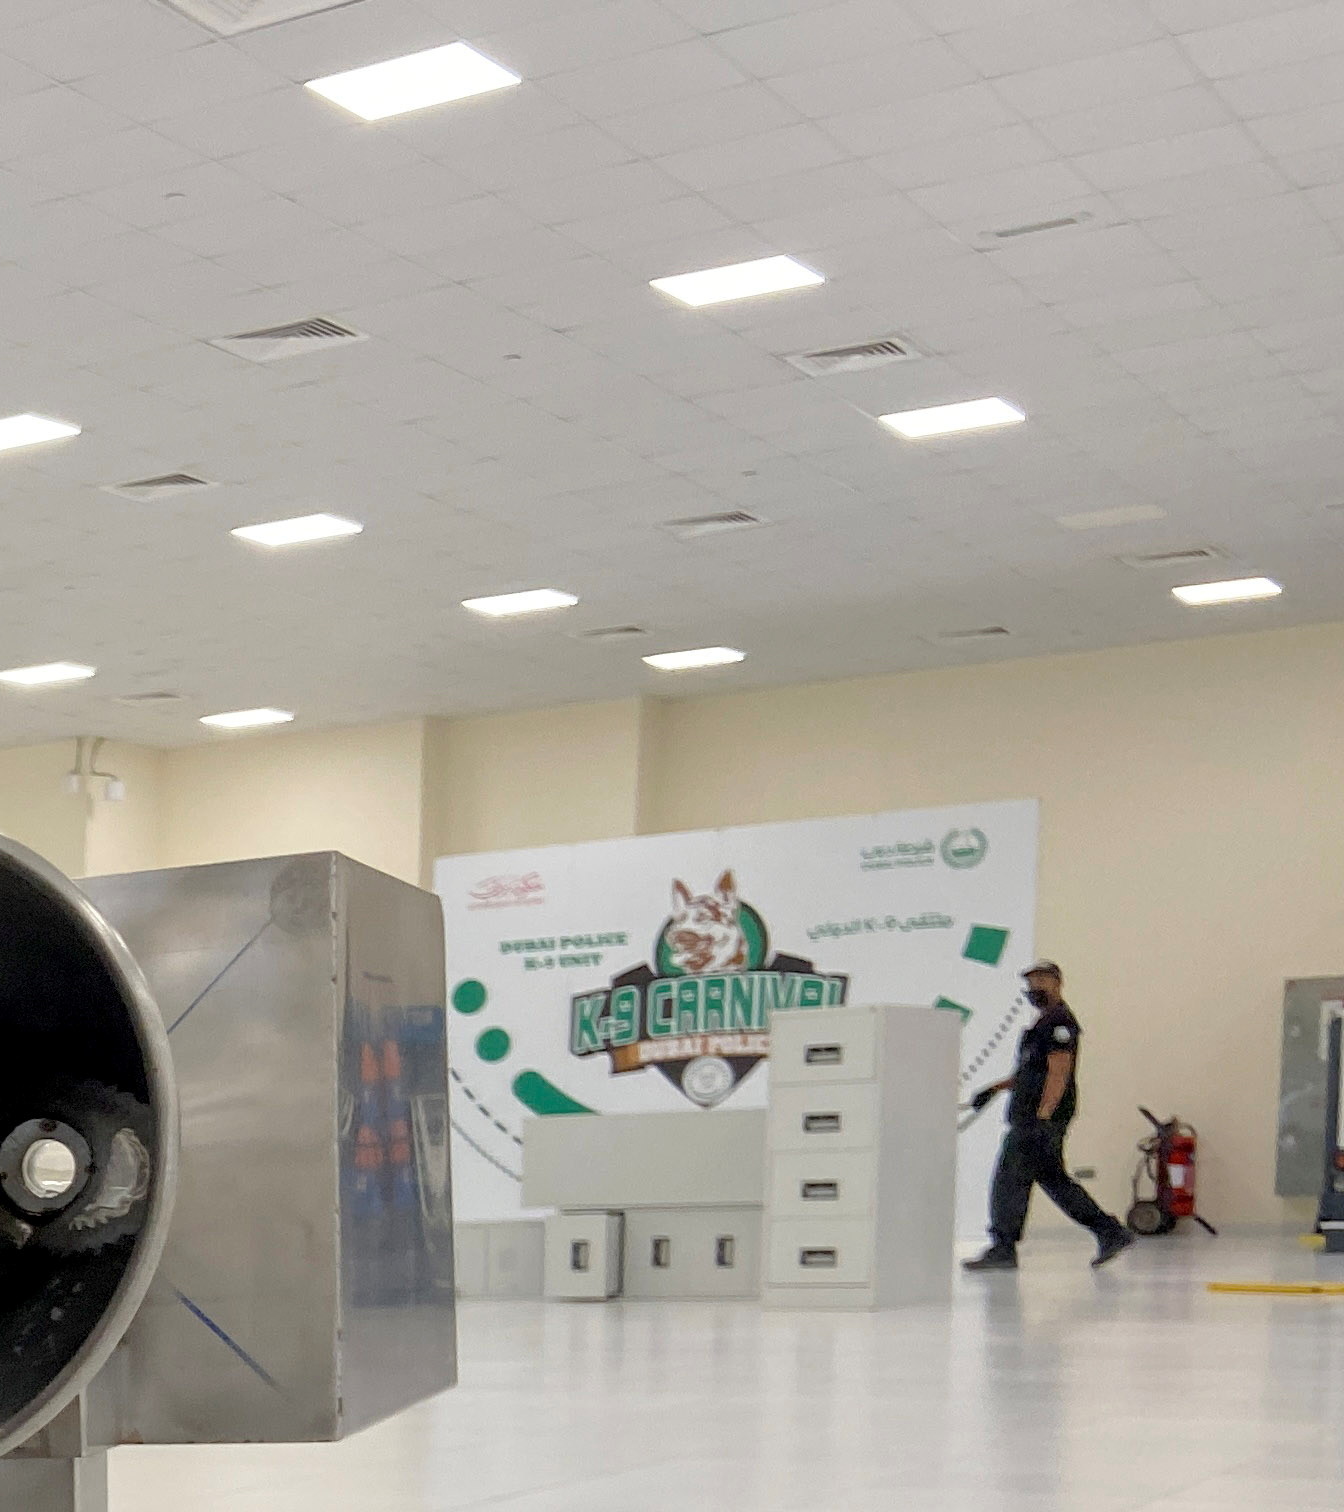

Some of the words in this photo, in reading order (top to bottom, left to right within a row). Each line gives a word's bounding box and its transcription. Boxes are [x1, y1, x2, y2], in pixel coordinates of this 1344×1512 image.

[499, 936, 555, 955] DUBAI
[559, 931, 629, 950] POLICE
[572, 984, 640, 1053] K-9
[708, 1034, 770, 1056] POLIC
